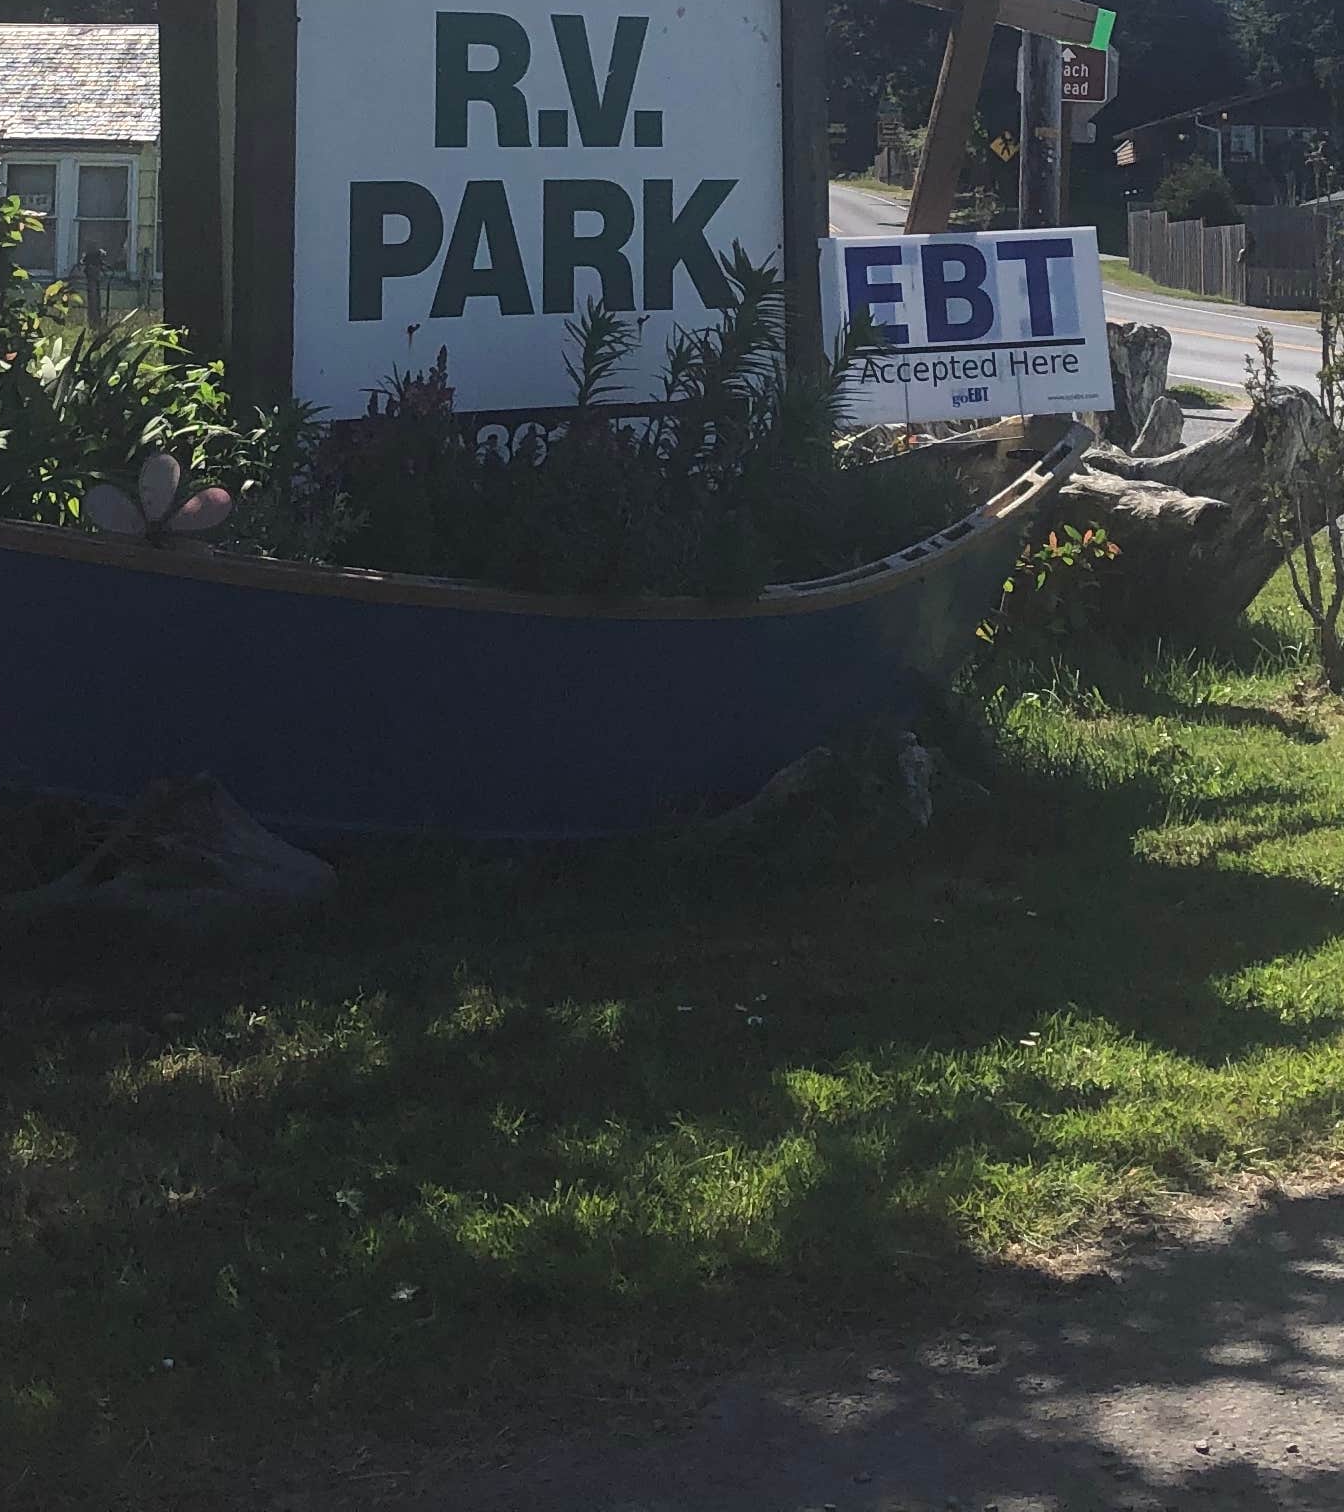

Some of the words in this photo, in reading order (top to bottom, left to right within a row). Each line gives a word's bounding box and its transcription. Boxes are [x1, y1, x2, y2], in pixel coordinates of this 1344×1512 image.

[434, 11, 664, 148] R.V.
[1063, 63, 1089, 77] ach
[348, 178, 740, 322] PARK
[844, 238, 1074, 345] EBT
[860, 351, 997, 388] Accepted
[1009, 350, 1079, 377] Here
[951, 386, 990, 408] goEBT
